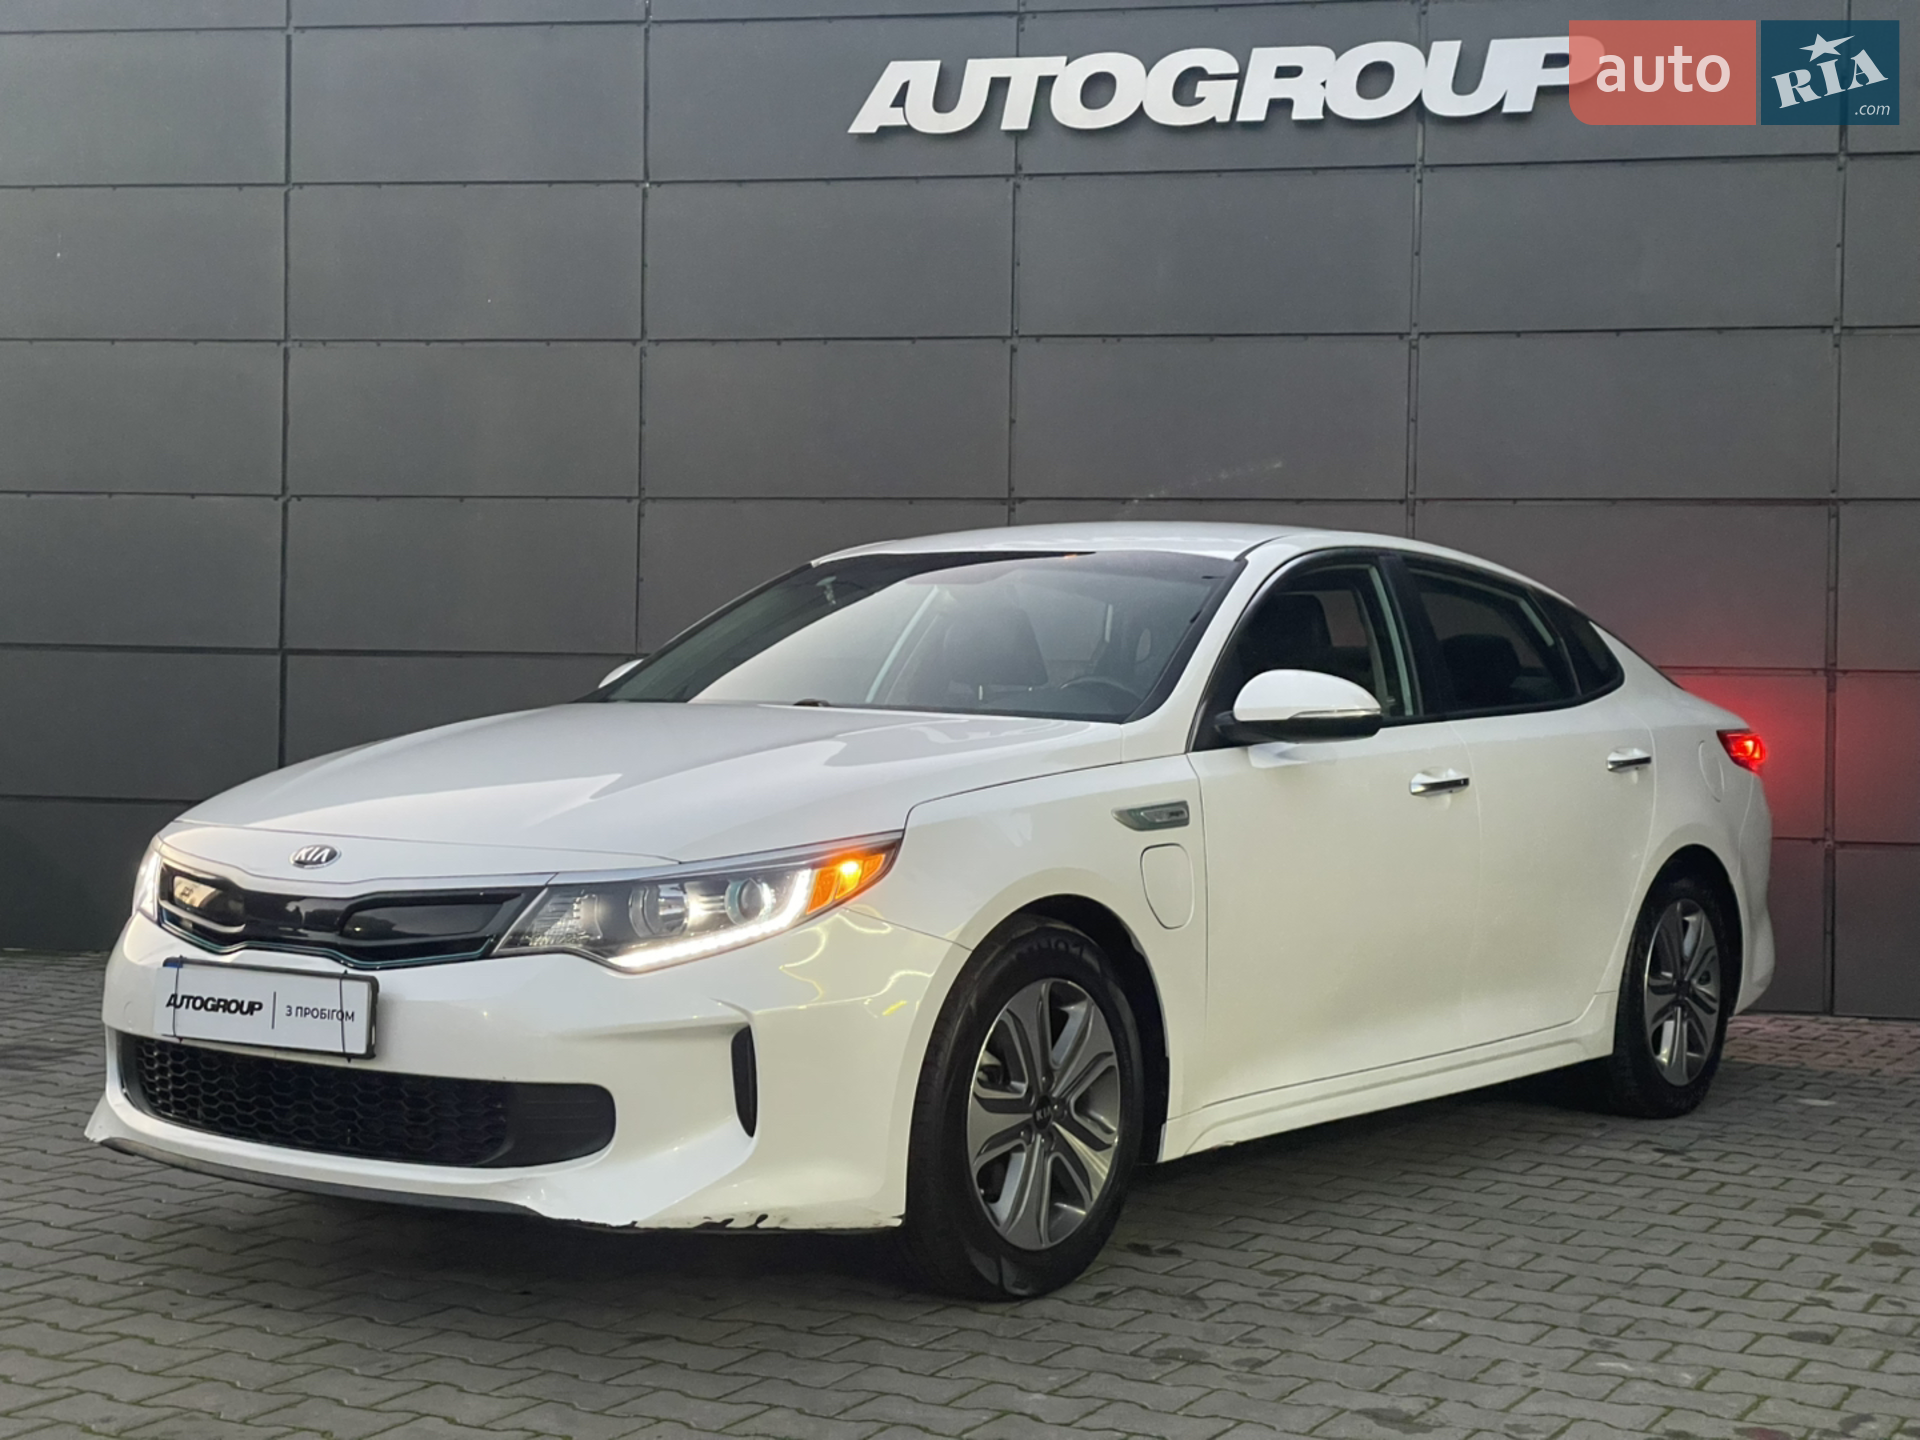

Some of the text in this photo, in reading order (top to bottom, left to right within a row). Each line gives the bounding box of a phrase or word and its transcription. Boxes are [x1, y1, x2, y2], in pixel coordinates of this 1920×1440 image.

[848, 36, 1604, 134] AUTOGROUP
[295, 845, 331, 862] KIA
[165, 993, 264, 1016] AUTOGROUP
[295, 1006, 355, 1022] ПРОБІГОМ
